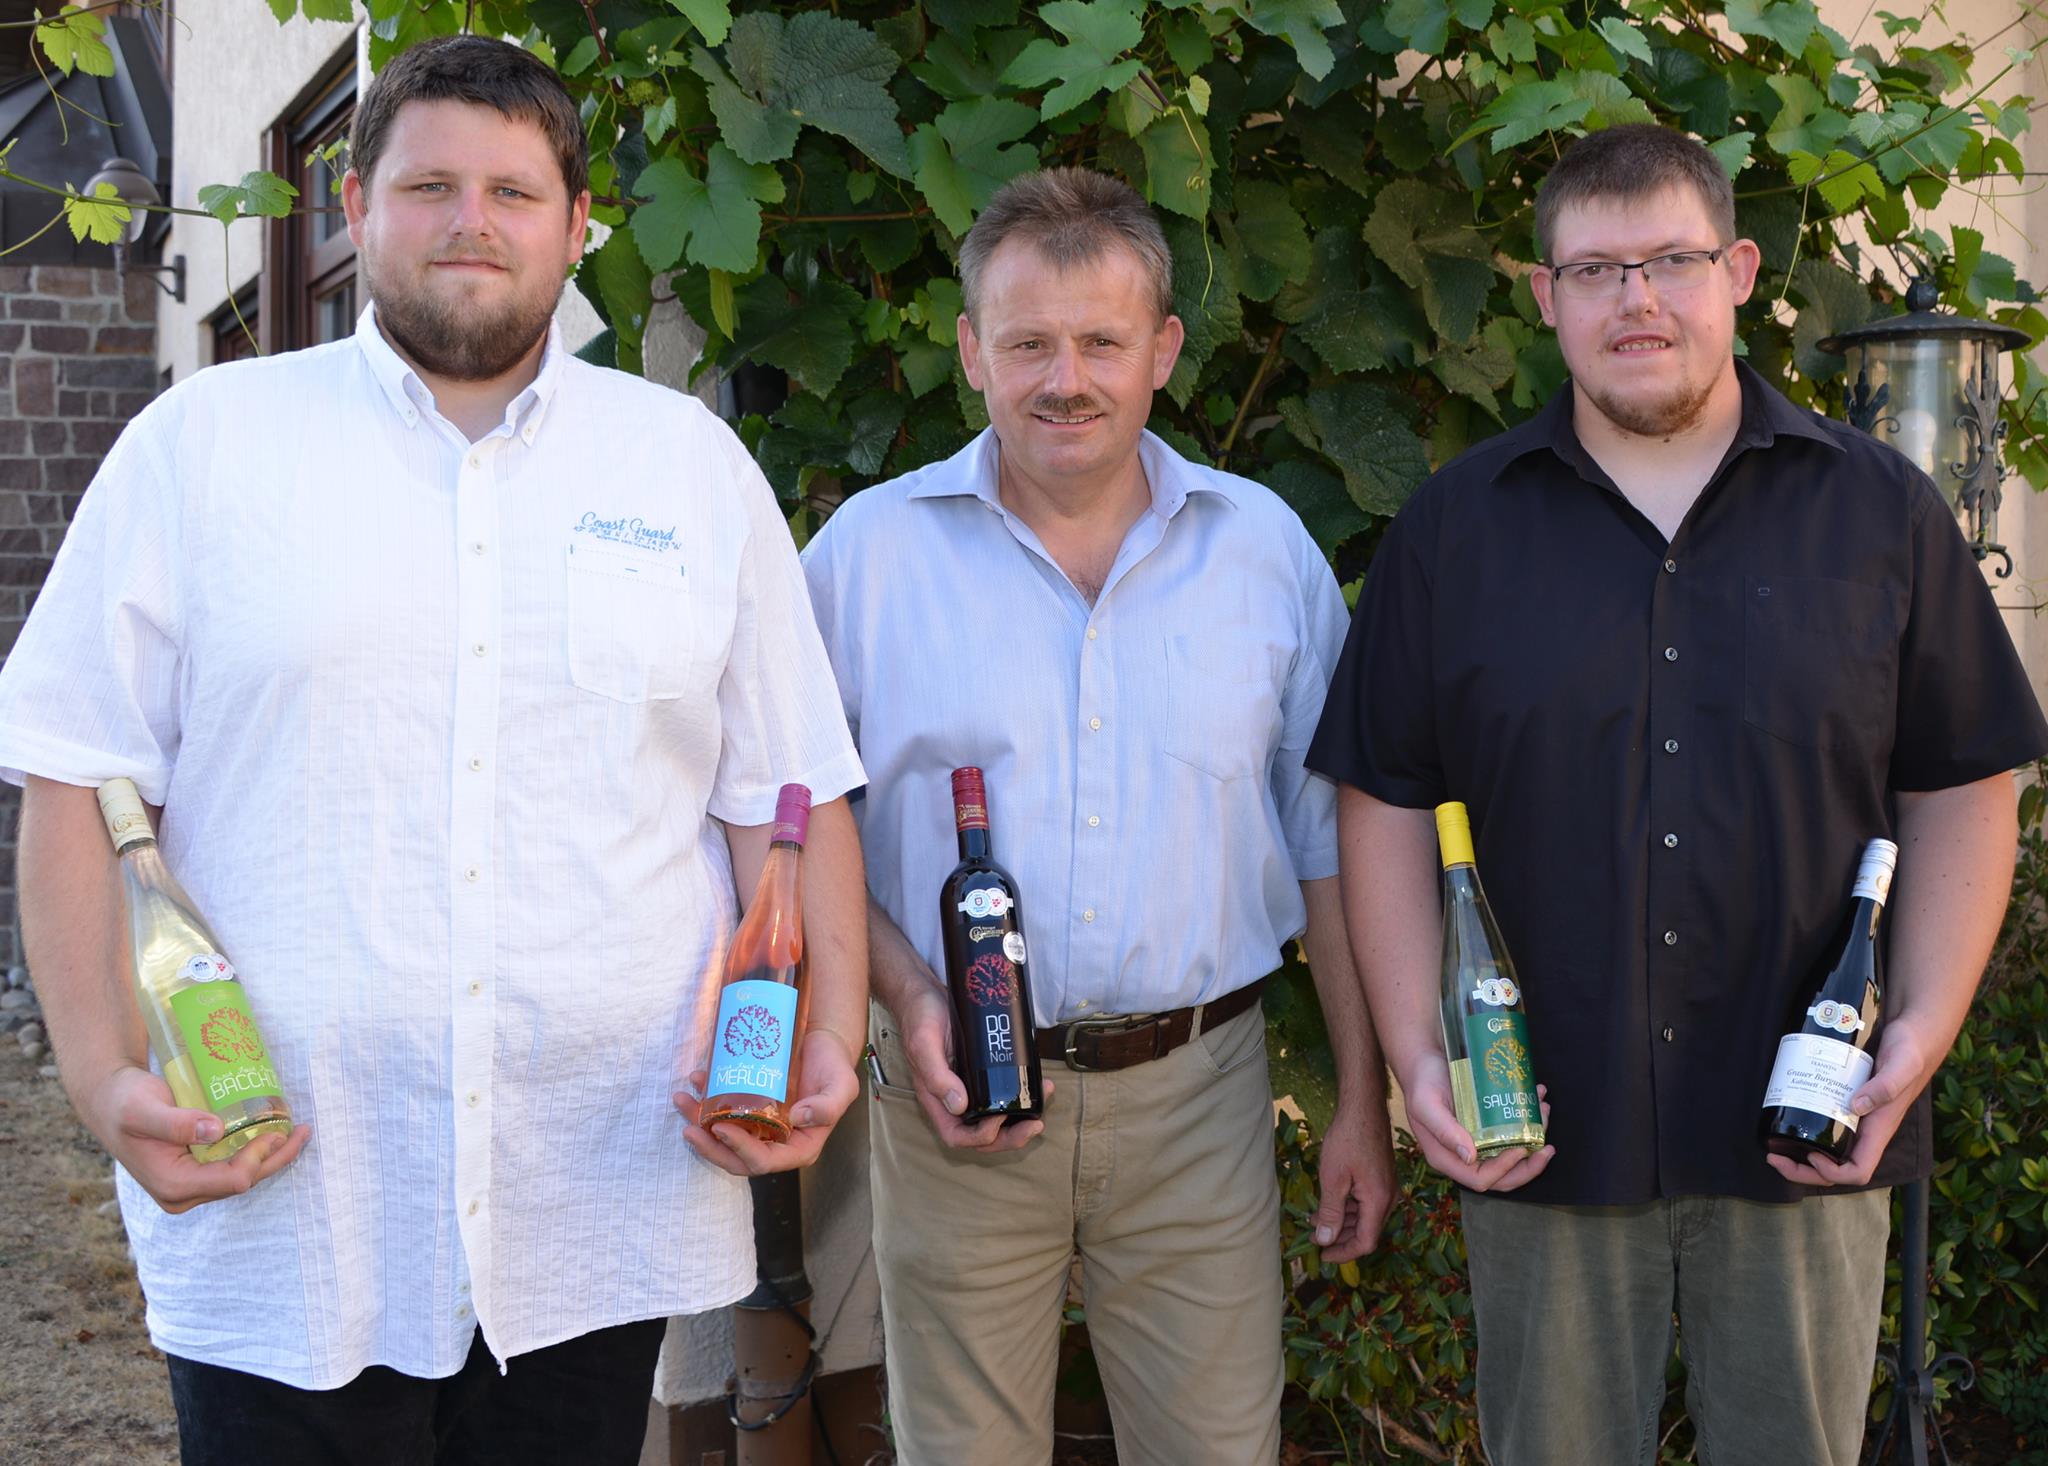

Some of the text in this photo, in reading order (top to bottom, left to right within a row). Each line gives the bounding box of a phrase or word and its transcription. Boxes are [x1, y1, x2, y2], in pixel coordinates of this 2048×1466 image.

[581, 511, 626, 531] Coast
[629, 518, 676, 541] Guard
[985, 1013, 1011, 1033] DO
[987, 1031, 1012, 1051] RE
[990, 1050, 1014, 1063] Noir
[715, 1068, 778, 1089] MERLOT
[1814, 1071, 1854, 1093] Burgunder
[1503, 1106, 1533, 1119] Blanc
